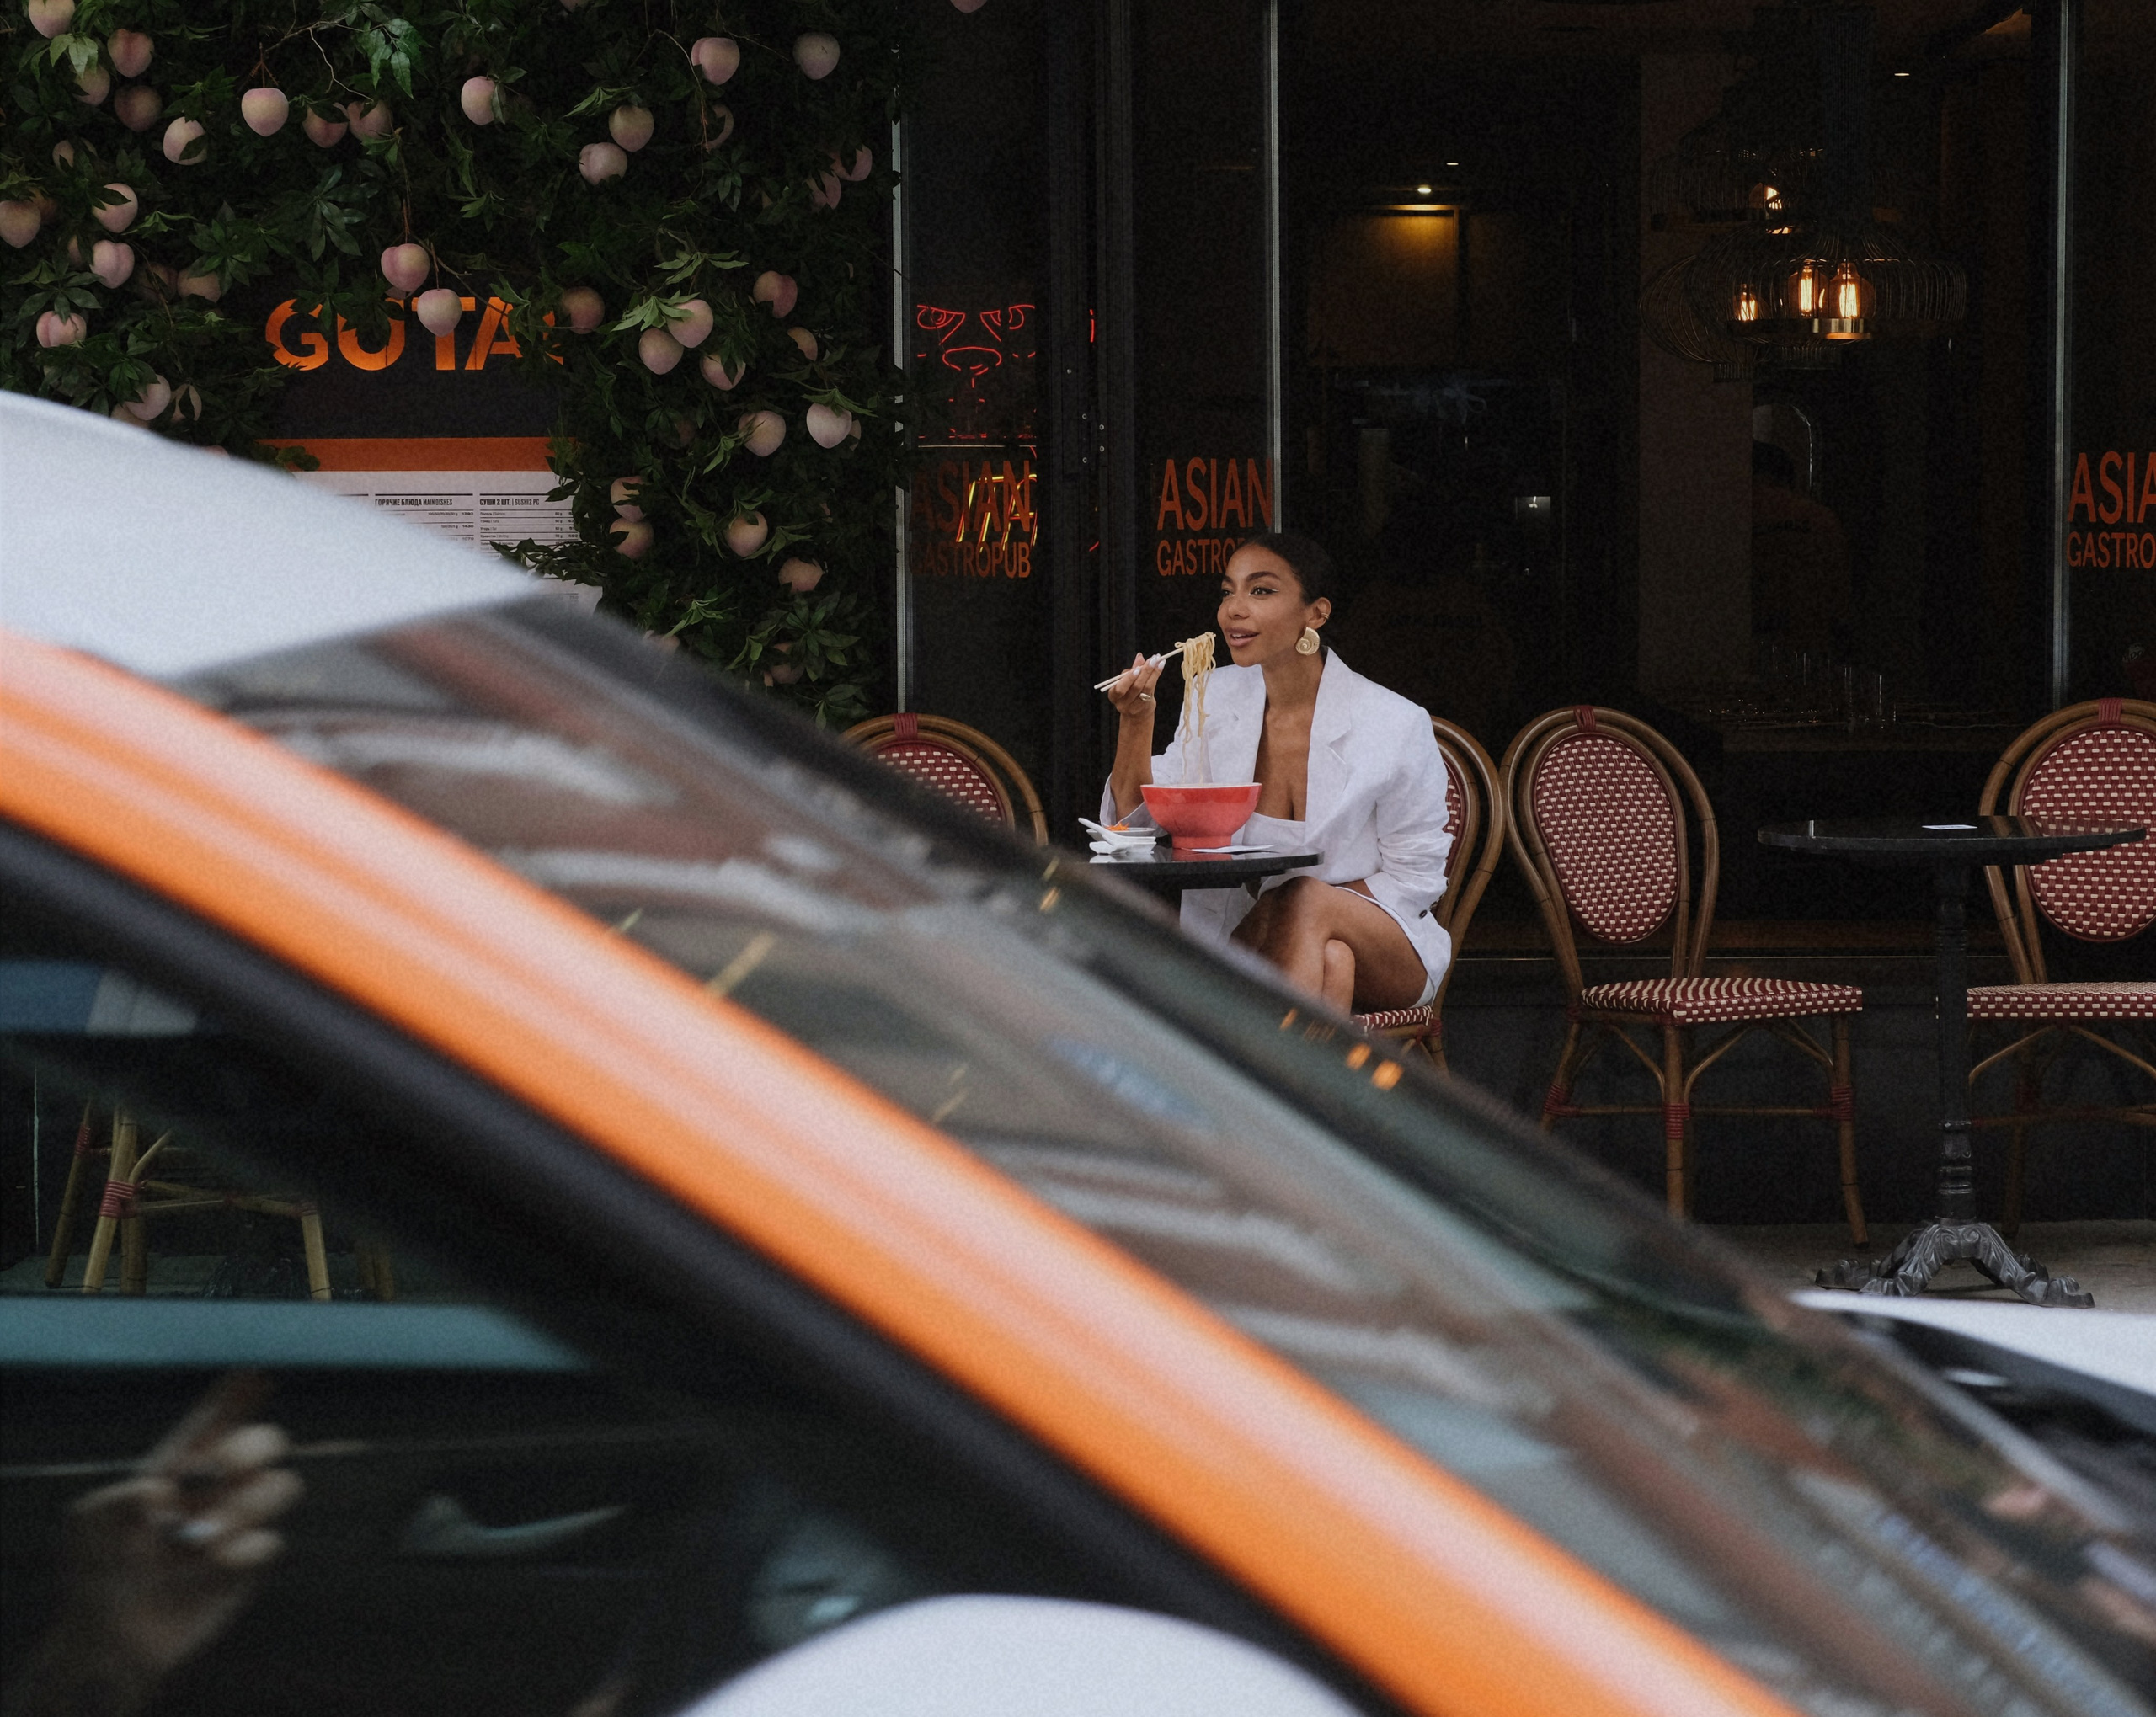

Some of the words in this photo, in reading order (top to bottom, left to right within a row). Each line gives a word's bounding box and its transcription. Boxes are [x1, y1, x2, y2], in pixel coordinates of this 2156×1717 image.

[265, 296, 563, 371] GUTA
[401, 499, 422, 507] БЛЮДА
[479, 498, 496, 506] СУШИ
[909, 459, 1031, 533] ASIAN
[1157, 456, 1273, 531] ASIAN
[2068, 451, 2156, 525] ASIA
[1157, 538, 1246, 576] GASTRO
[2067, 531, 2156, 569] GASTRO
